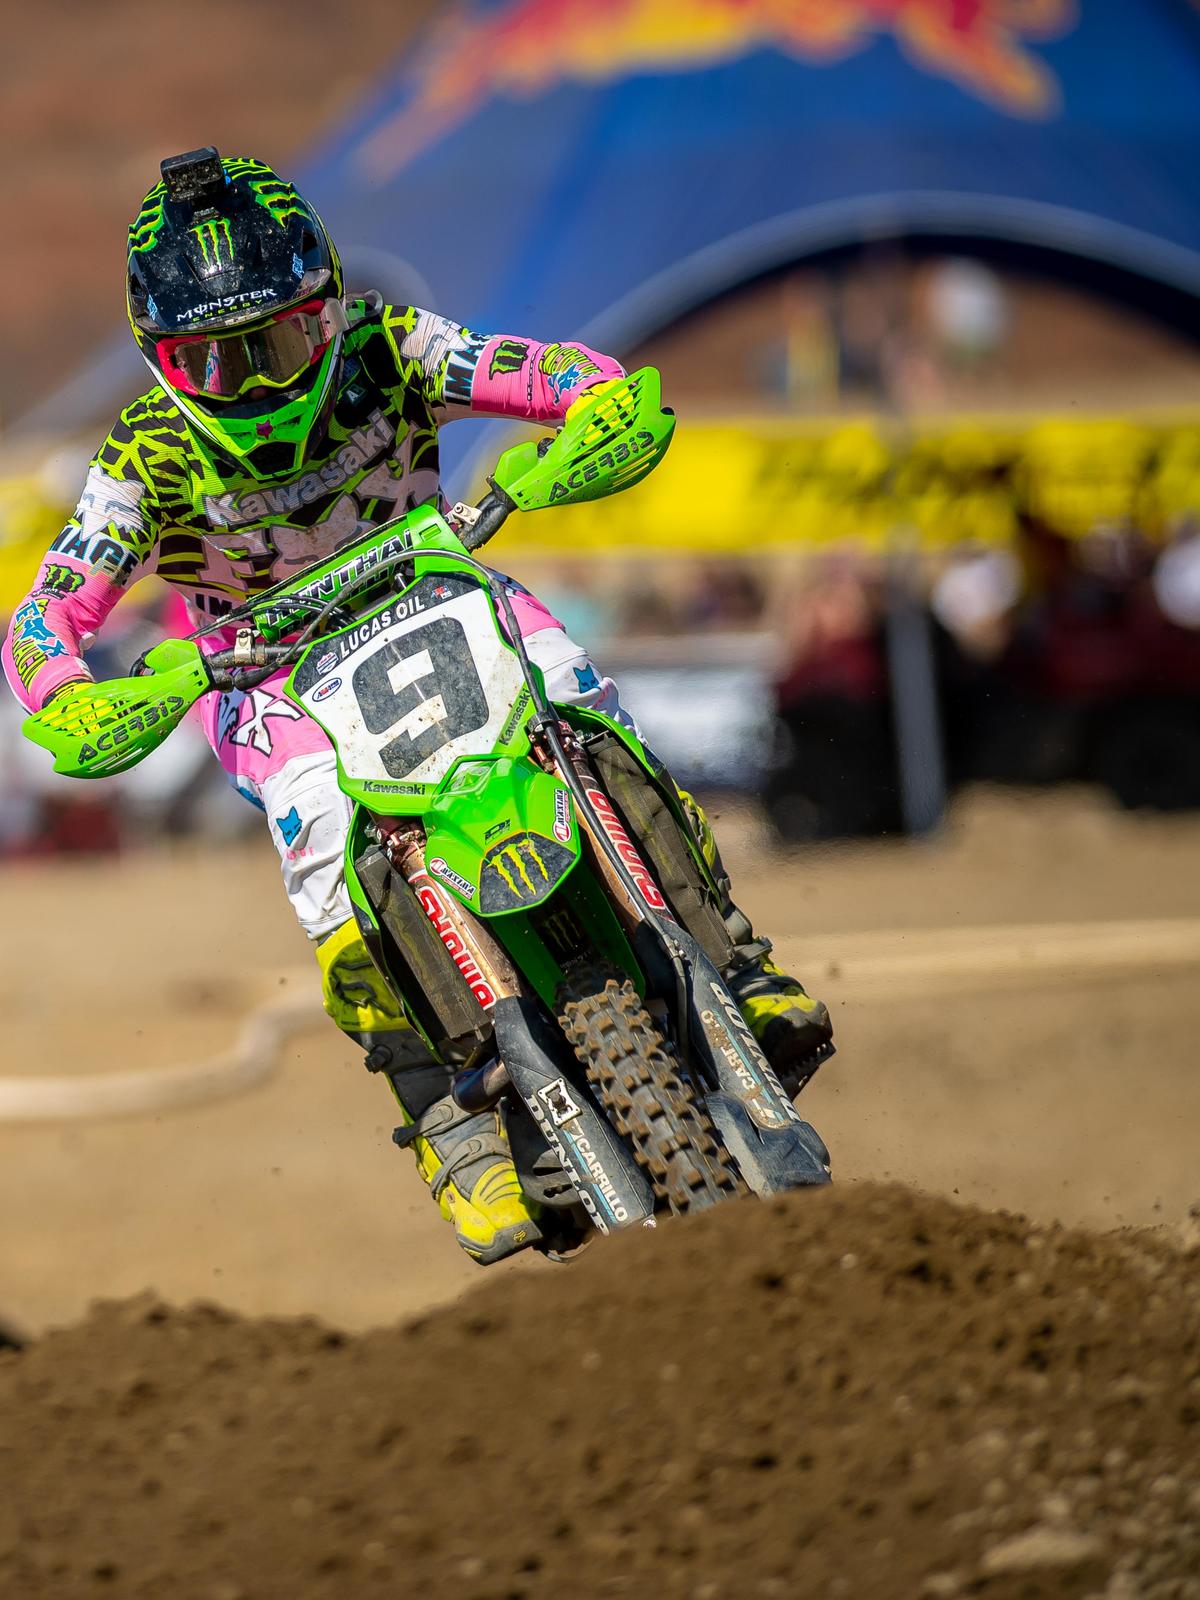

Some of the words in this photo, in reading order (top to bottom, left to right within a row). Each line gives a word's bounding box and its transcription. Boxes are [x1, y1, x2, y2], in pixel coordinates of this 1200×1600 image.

[175, 287, 277, 322] MONSTER
[202, 407, 396, 527] Kawasaki
[340, 611, 392, 659] LUCAS
[395, 596, 426, 621] OIL
[352, 617, 490, 779] 9
[498, 687, 531, 746] Kawasaki
[363, 780, 426, 796] Kawasaki
[575, 1137, 628, 1222] CARRILLO
